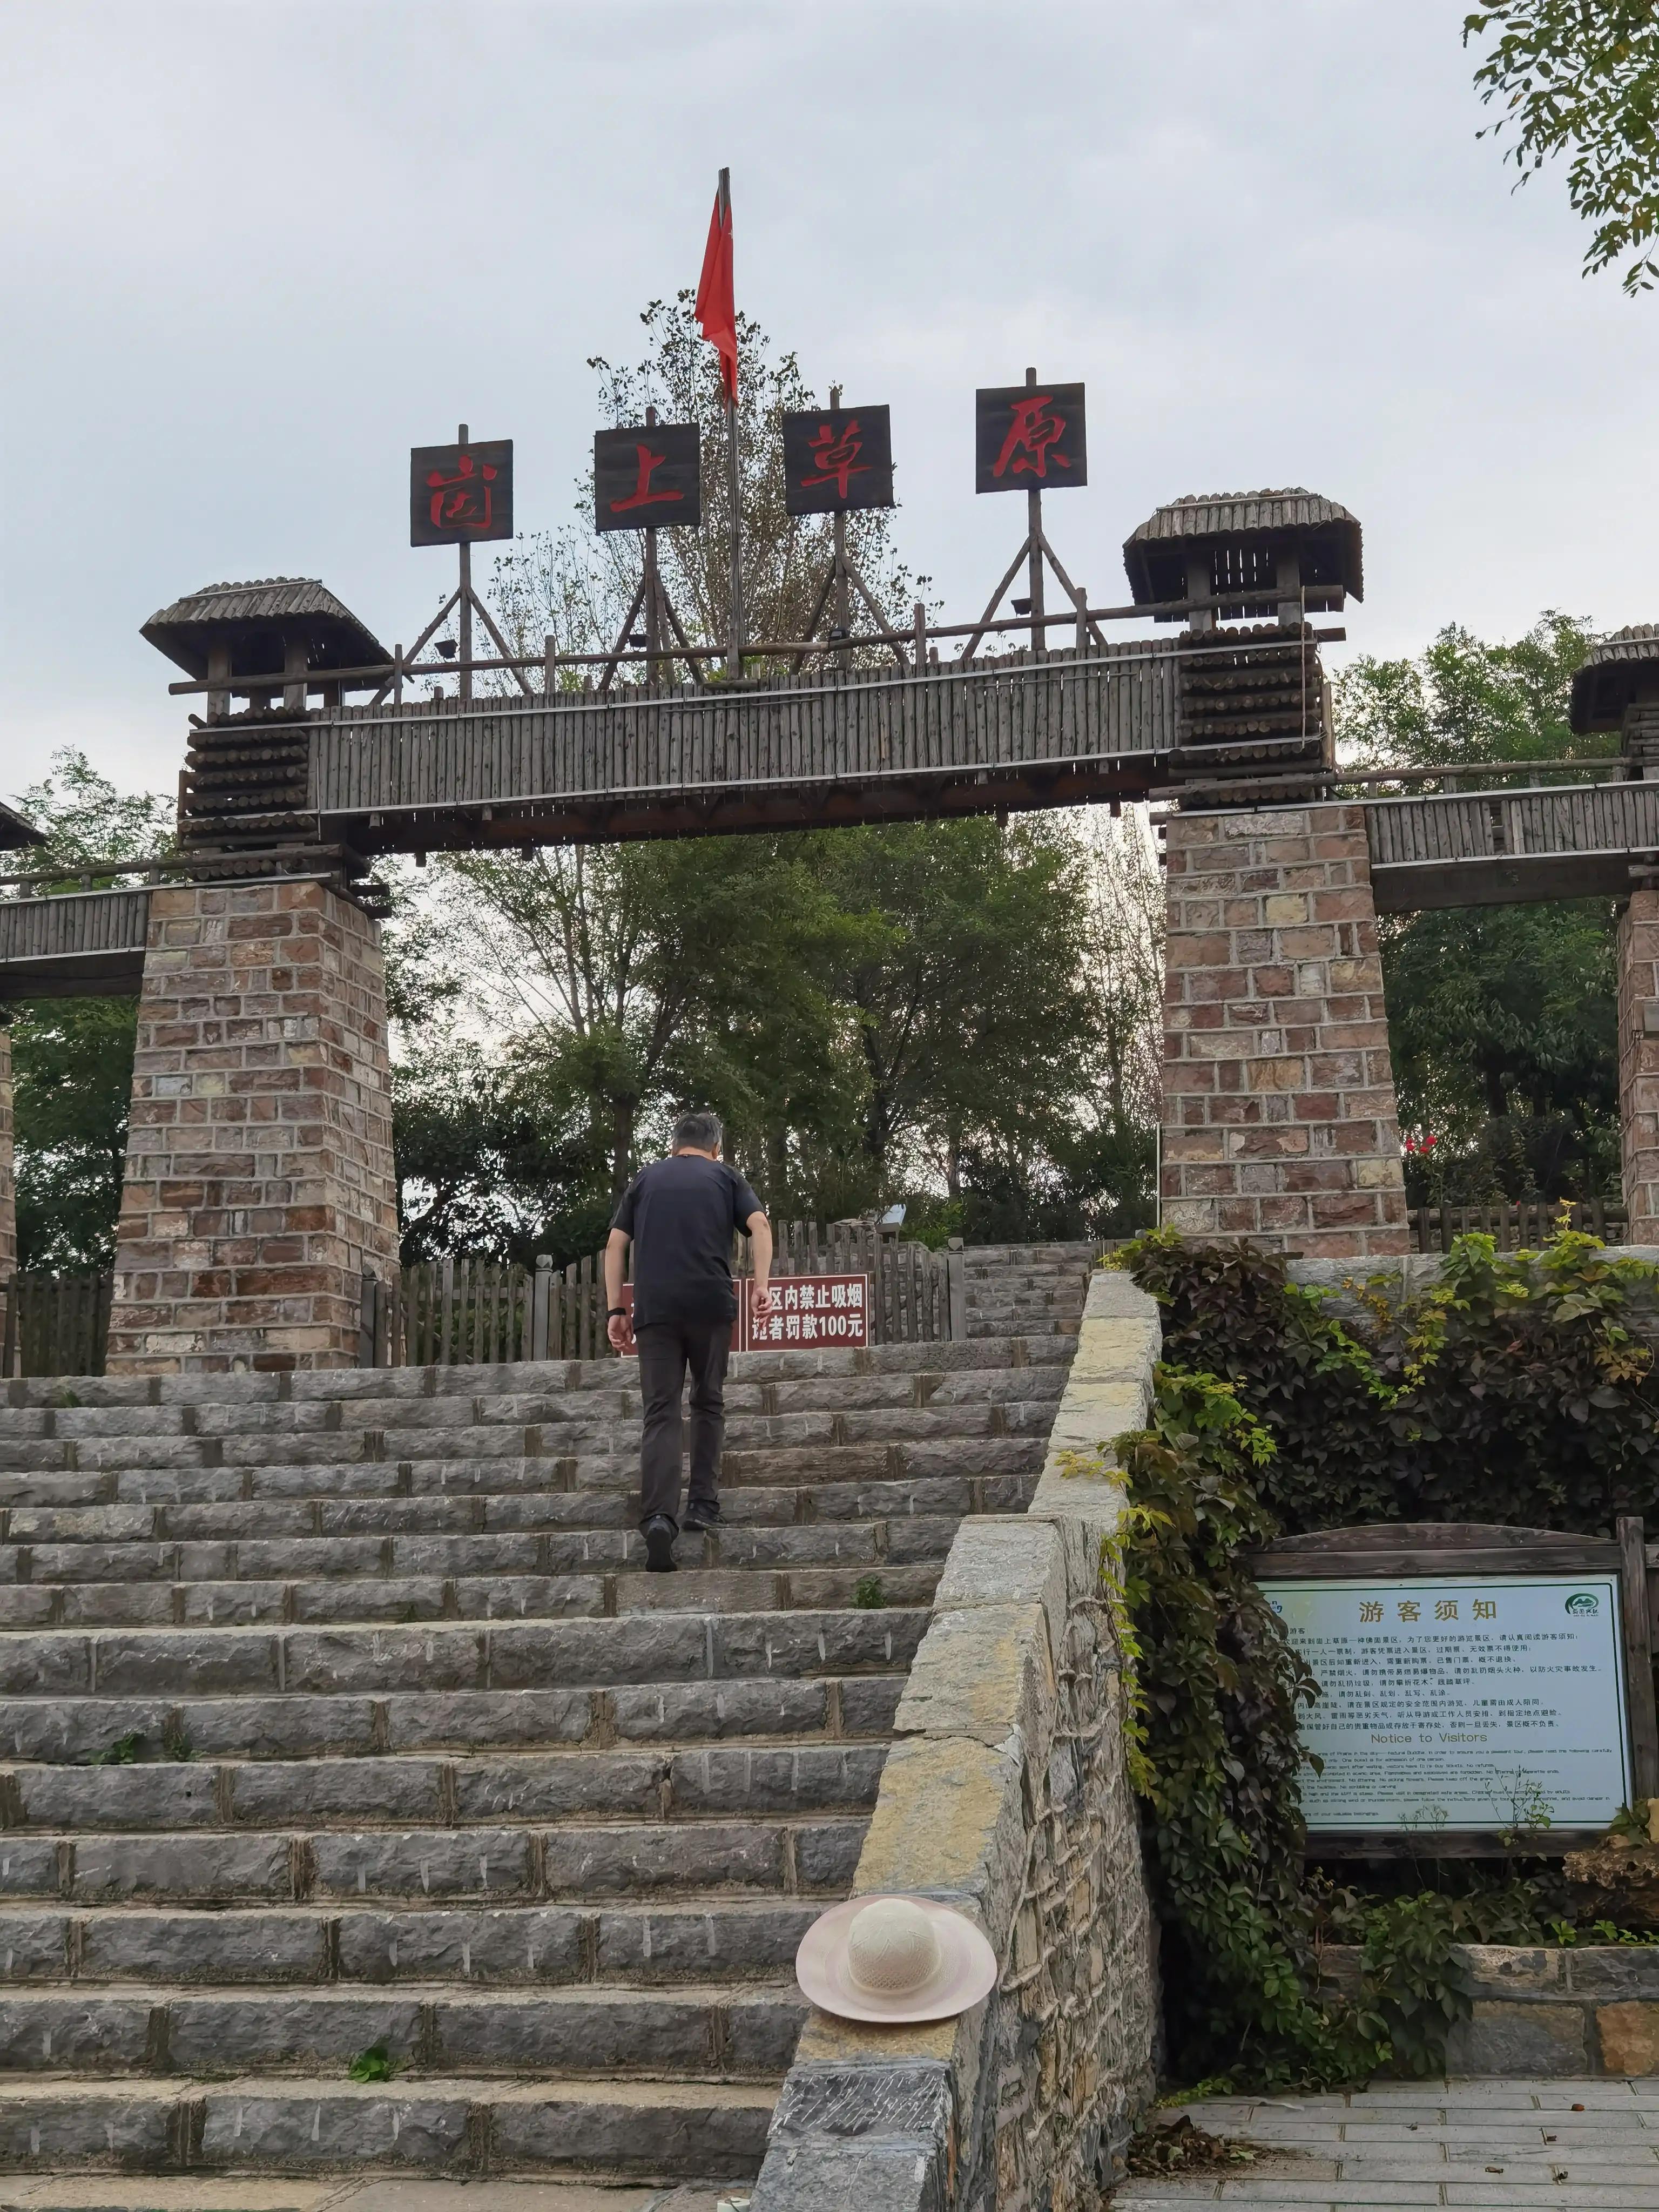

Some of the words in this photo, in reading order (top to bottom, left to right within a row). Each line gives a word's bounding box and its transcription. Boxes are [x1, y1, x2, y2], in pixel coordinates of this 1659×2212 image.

[1358, 1599, 1496, 1623] 游客须知
[1371, 1734, 1412, 1744] Notice
[1418, 1732, 1432, 1743] to
[1439, 1732, 1488, 1743] Visitors
